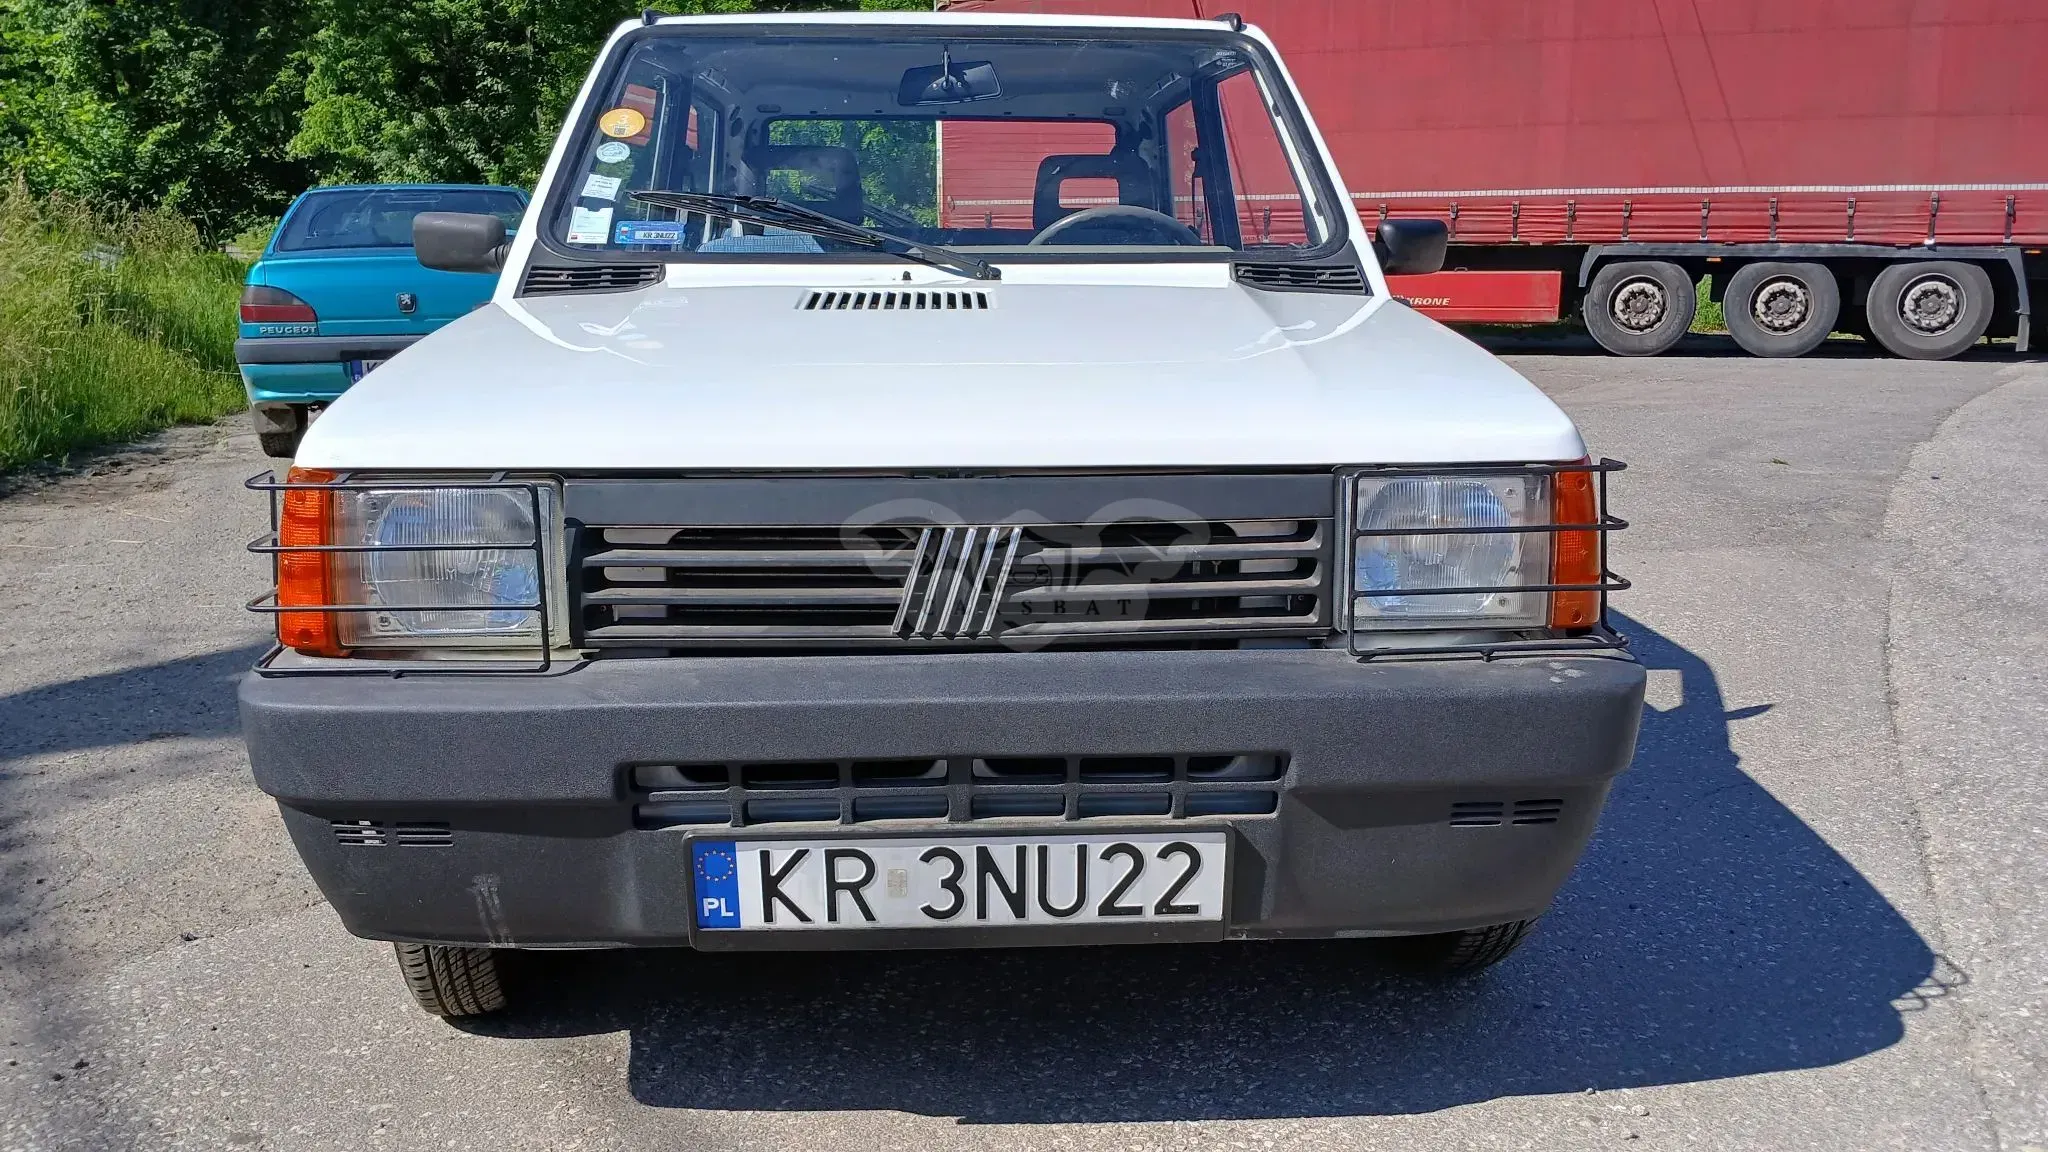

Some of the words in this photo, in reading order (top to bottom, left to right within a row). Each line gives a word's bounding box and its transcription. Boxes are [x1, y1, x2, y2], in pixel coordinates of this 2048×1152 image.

[259, 326, 317, 334] PEUGEOT
[757, 848, 877, 924] KR
[917, 841, 1204, 921] 3NU22
[702, 896, 735, 918] PL
